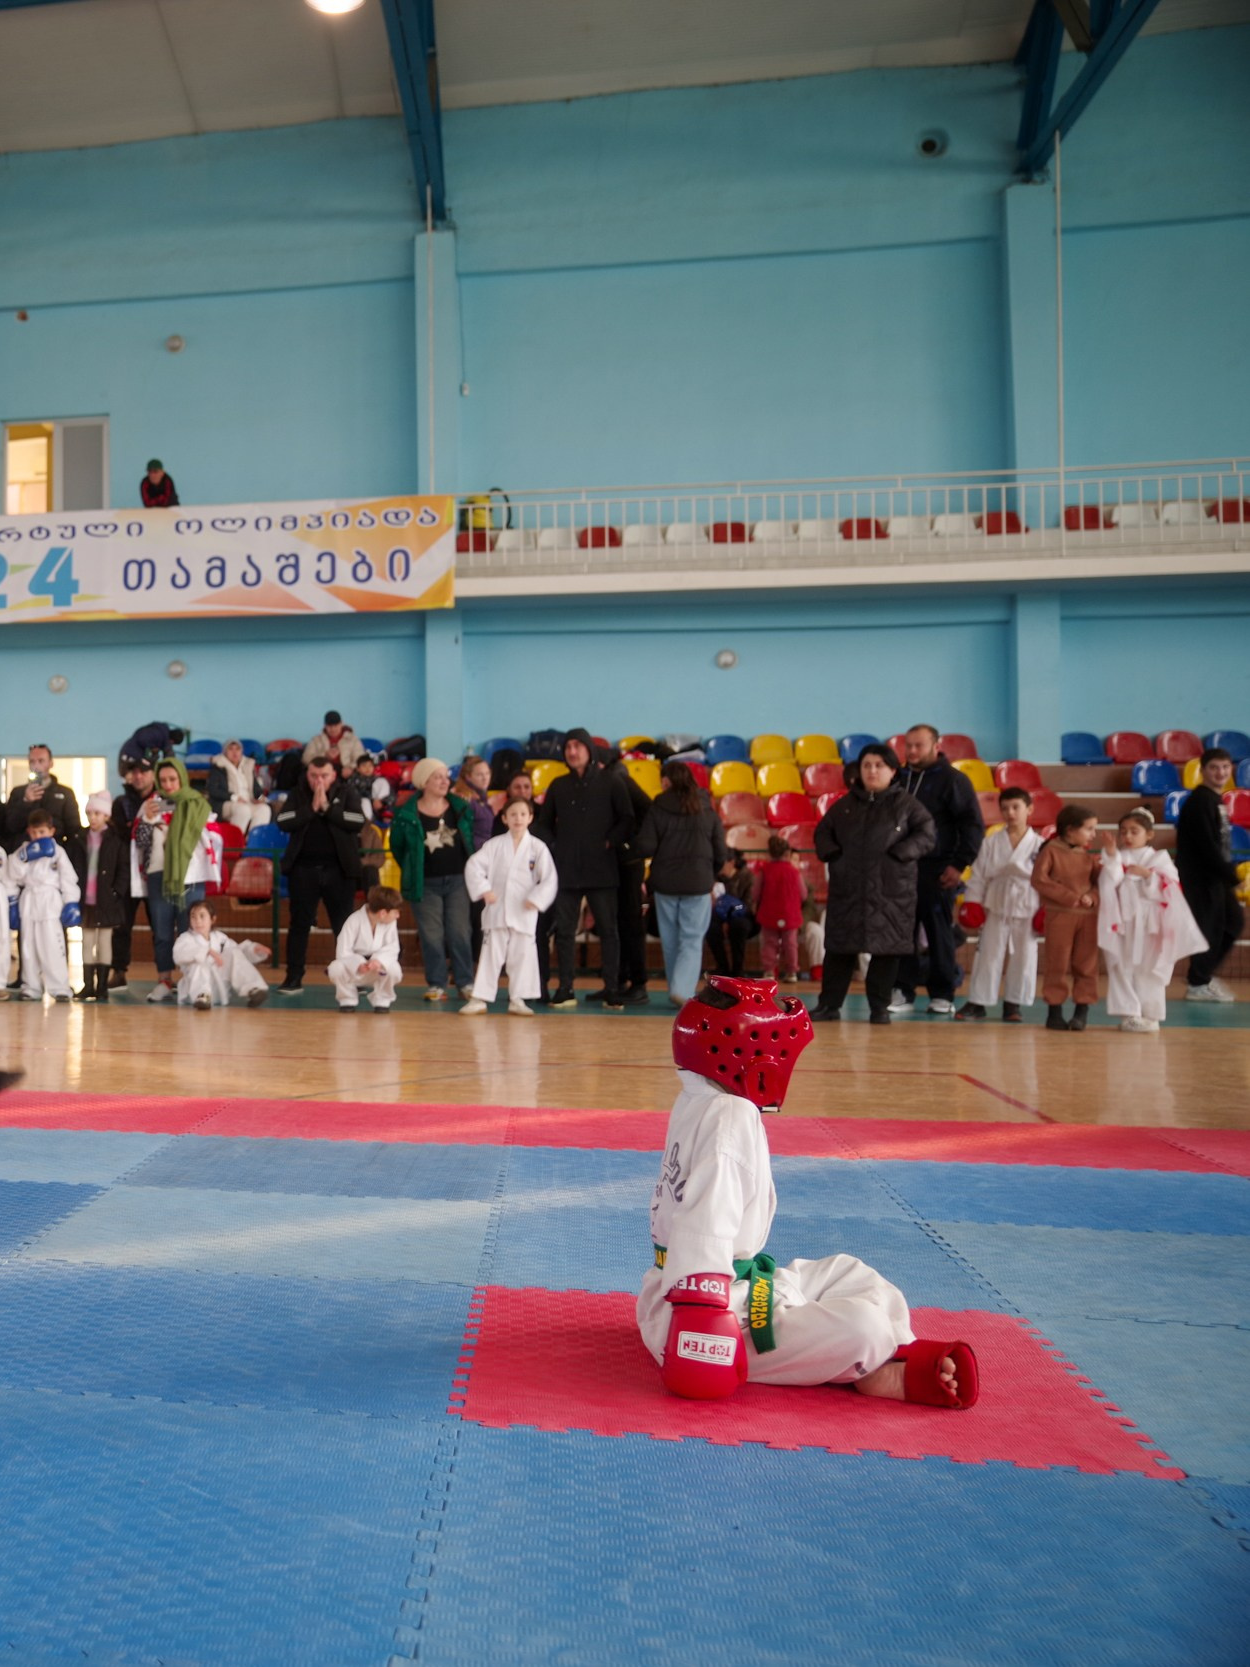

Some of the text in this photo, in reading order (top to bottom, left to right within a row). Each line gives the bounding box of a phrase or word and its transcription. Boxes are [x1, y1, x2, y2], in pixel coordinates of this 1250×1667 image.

[174, 506, 440, 536] ოლიმპიადა
[122, 546, 412, 591] თამაშები
[673, 1277, 726, 1296] TOP TE
[683, 1340, 707, 1353] TEN
[709, 1343, 731, 1357] TOP
